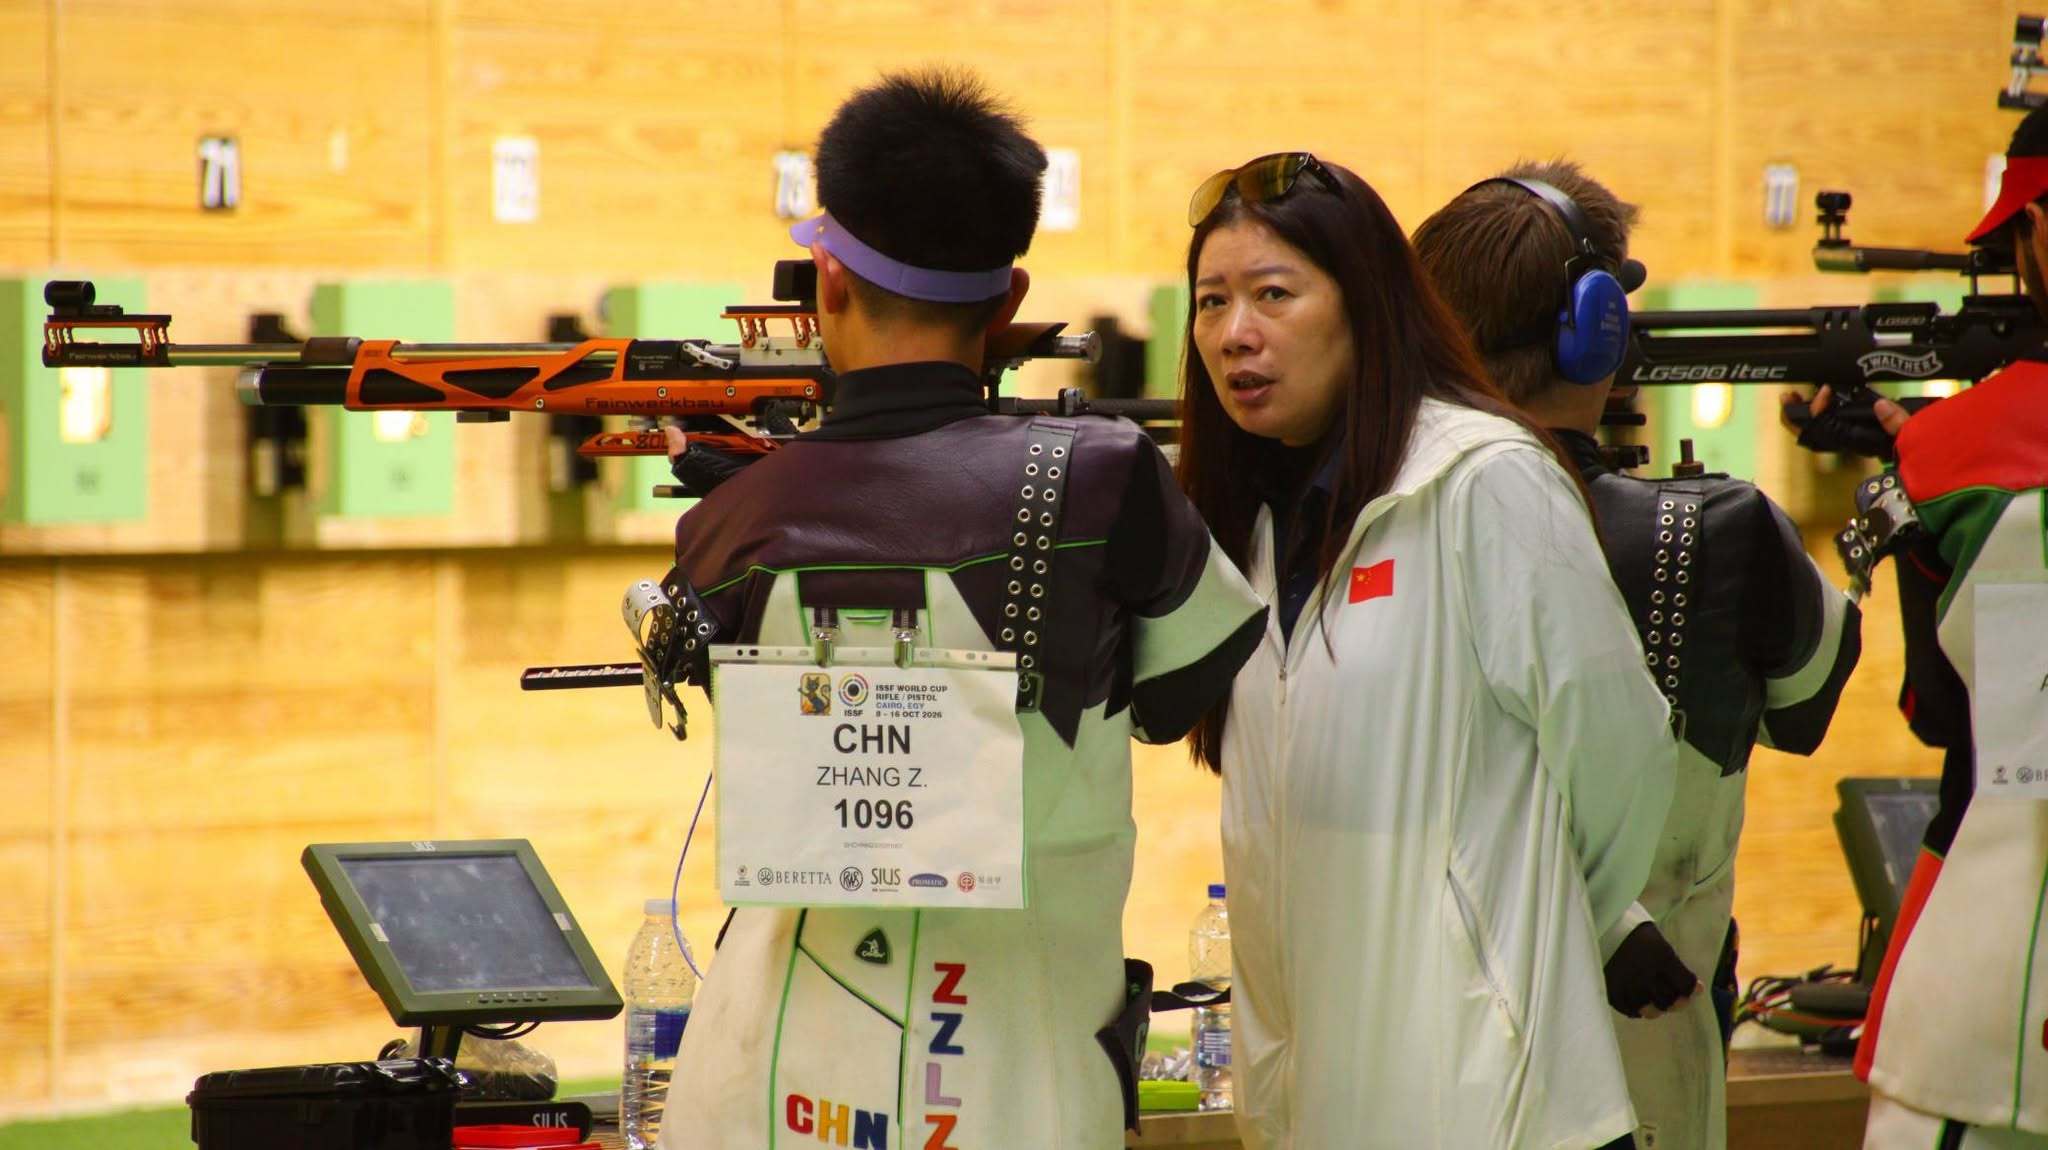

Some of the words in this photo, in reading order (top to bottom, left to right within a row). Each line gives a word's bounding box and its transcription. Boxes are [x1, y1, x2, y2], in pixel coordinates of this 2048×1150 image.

[1632, 365, 1728, 381] LG500
[1730, 363, 1788, 379] itec
[1869, 356, 1931, 372] WALTHER
[875, 684, 894, 692] ISSF
[844, 709, 864, 717] ISSF
[833, 723, 911, 754] CHN
[817, 766, 900, 787] ZHANG
[908, 768, 928, 788] Z.
[834, 798, 914, 829] 1096
[776, 870, 833, 885] BERETTA
[871, 867, 901, 885] SIUS
[785, 1094, 889, 1150] CHN
